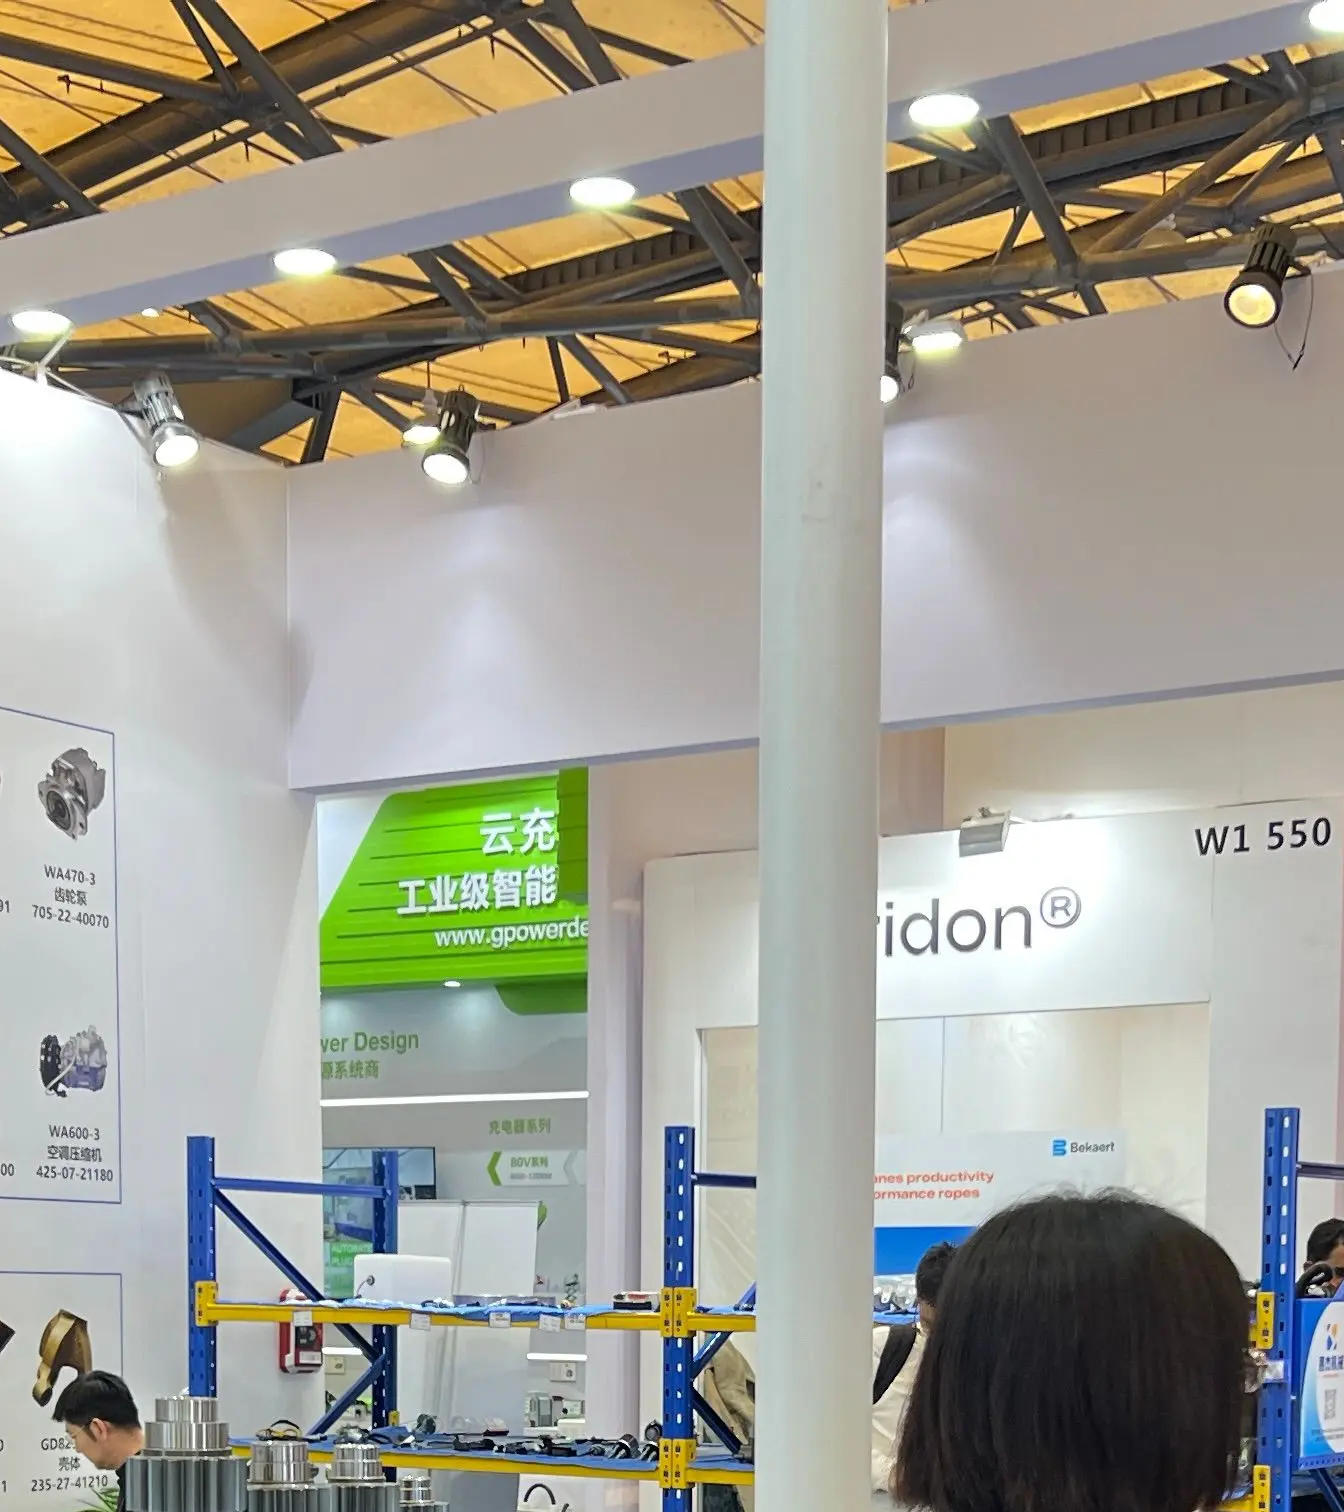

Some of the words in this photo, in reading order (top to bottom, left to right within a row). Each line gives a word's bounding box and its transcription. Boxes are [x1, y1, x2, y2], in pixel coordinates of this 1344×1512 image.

[479, 807, 558, 856] 云充
[1193, 823, 1251, 857] W1
[1266, 816, 1333, 852] 550
[43, 863, 97, 887] WA470-3
[54, 885, 89, 908] 齿轮泵
[396, 864, 558, 916] 工业级智能
[31, 904, 111, 931] 705-22-40070
[354, 1030, 420, 1056] Design
[47, 1123, 101, 1143] WA600-3
[46, 1143, 103, 1164] 空调压缩机
[1069, 1138, 1116, 1155] Bekaert
[35, 1164, 115, 1185] 425-07-21180
[906, 1170, 995, 1185] productivity
[937, 1187, 981, 1202] ropes
[58, 1456, 81, 1472] 壳体
[30, 1474, 109, 1492] 235-27-41210
